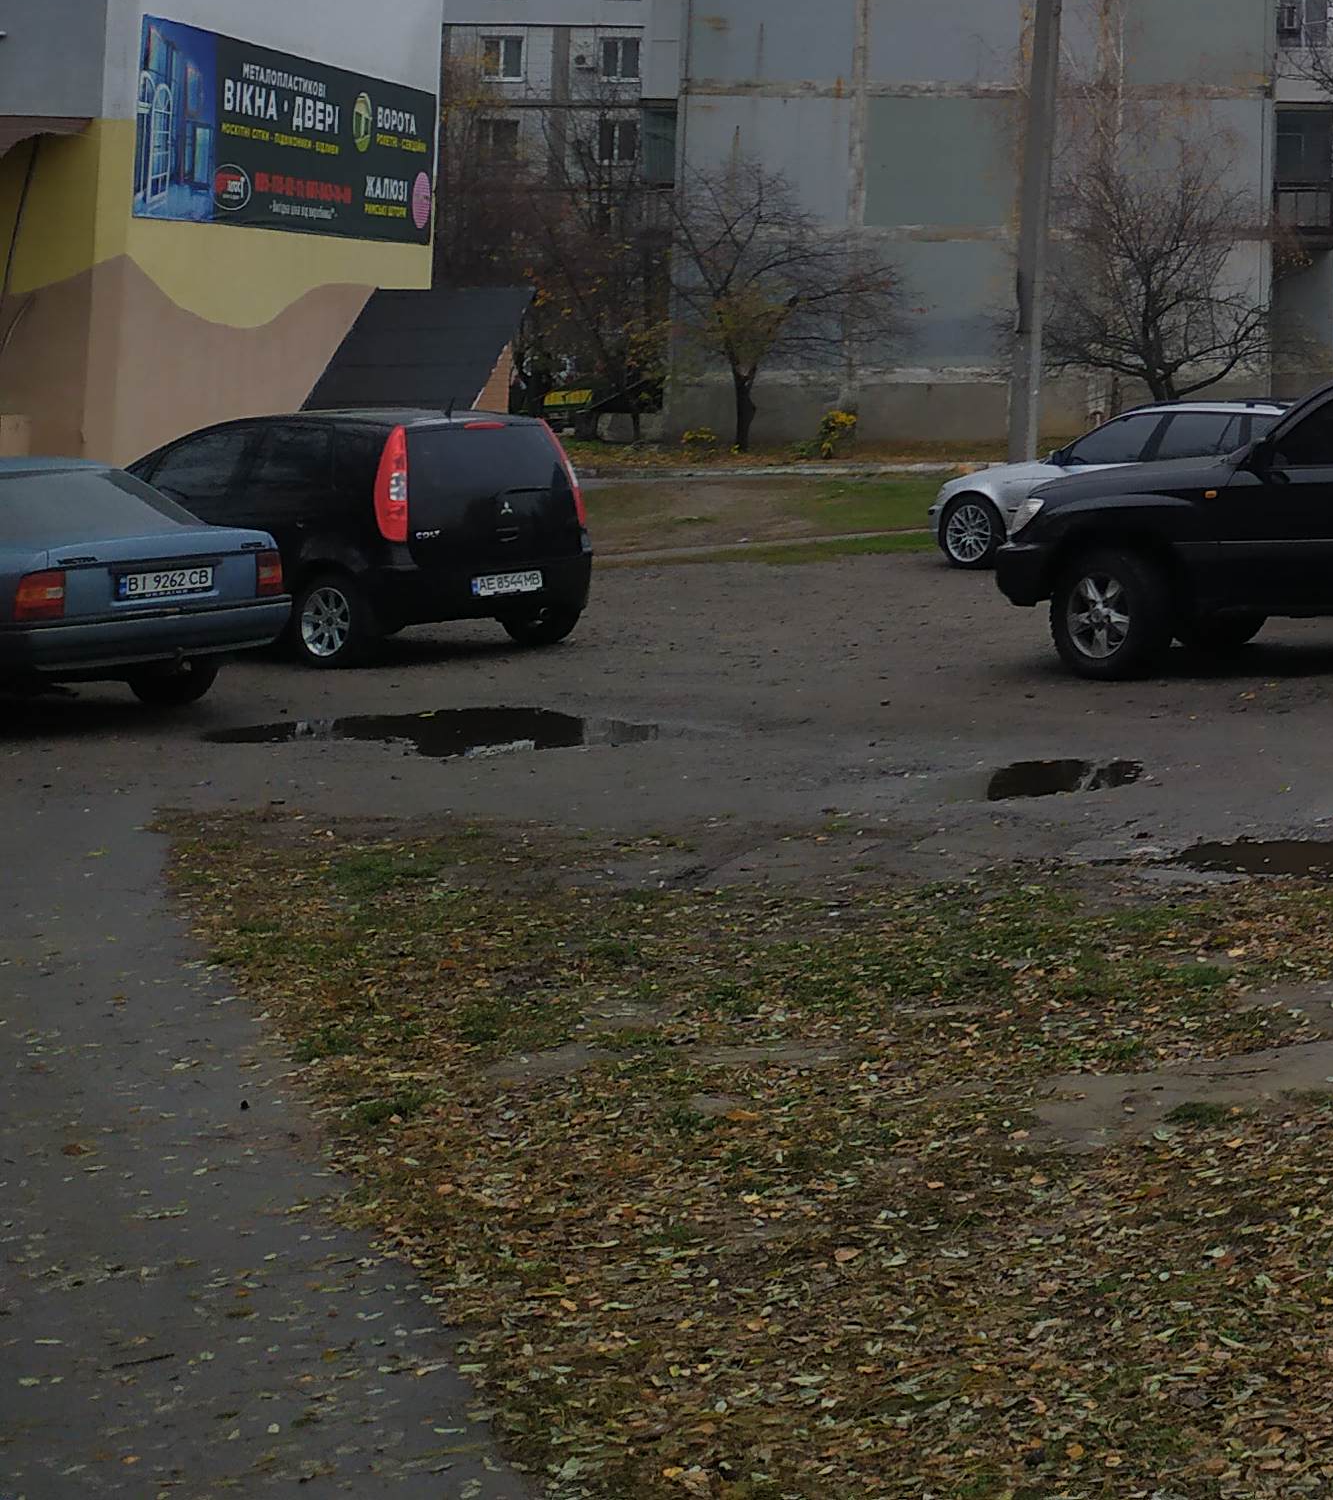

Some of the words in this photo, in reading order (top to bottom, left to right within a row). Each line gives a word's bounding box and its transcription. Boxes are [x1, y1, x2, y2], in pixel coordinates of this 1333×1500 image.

[242, 62, 326, 98] МЕТАЛОПЛАСТИКОВІ
[223, 78, 278, 121] ВІКНА
[292, 95, 340, 135] ДВЕРІ
[376, 105, 417, 135] ВОРОТА
[364, 175, 409, 202] ЖАЛЮЗІ
[128, 575, 146, 592] BI
[153, 571, 186, 590] 9262
[188, 569, 209, 586] CB
